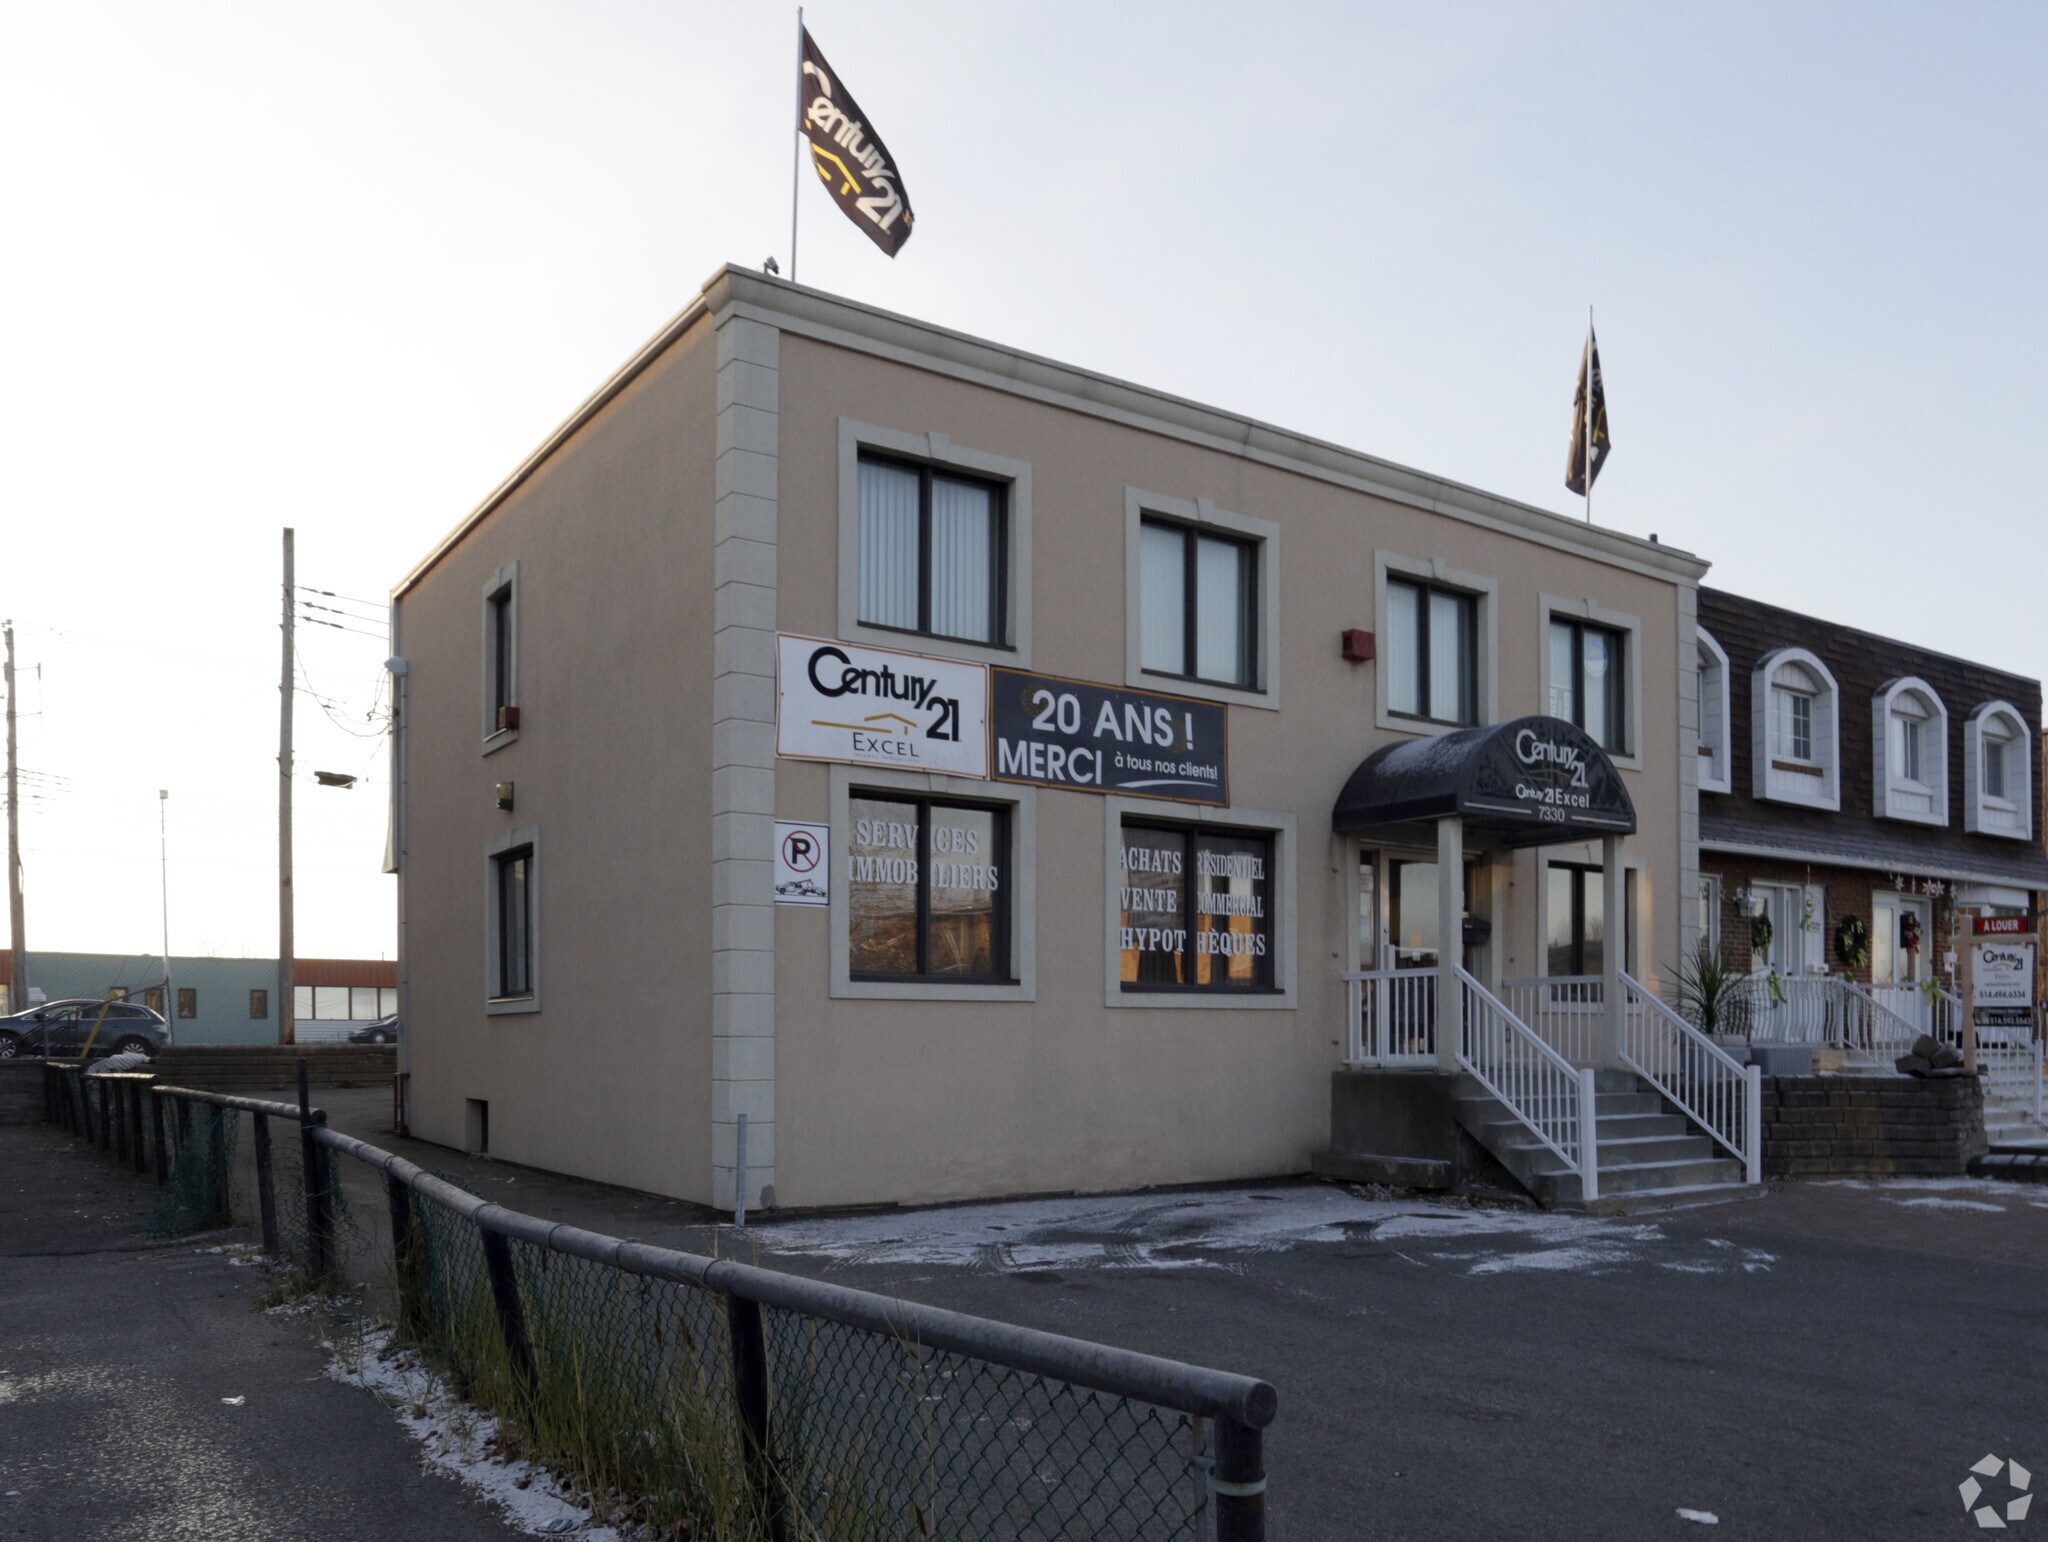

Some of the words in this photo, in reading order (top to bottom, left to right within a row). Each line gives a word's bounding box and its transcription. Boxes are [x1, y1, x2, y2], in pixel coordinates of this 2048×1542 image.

[855, 177, 904, 234] 21
[808, 646, 937, 709] Century
[926, 697, 959, 742] 21
[1032, 689, 1081, 735] 20
[1093, 700, 1174, 748] ANS
[853, 732, 919, 757] EXCEL
[1516, 728, 1579, 769] Century
[1570, 760, 1588, 788] 21
[998, 738, 1102, 785] MERCI
[1114, 751, 1124, 767] à
[1127, 754, 1152, 771] tous
[1155, 760, 1176, 774] nos
[1179, 761, 1218, 780] clients!
[1556, 788, 1590, 808] Excel
[1538, 806, 1565, 822] 7330
[1120, 846, 1182, 874] ACHATS
[1120, 887, 1177, 913] VENTE
[1992, 919, 2019, 931] LOUER
[1983, 950, 2016, 963] Century
[2013, 958, 2023, 970] 21
